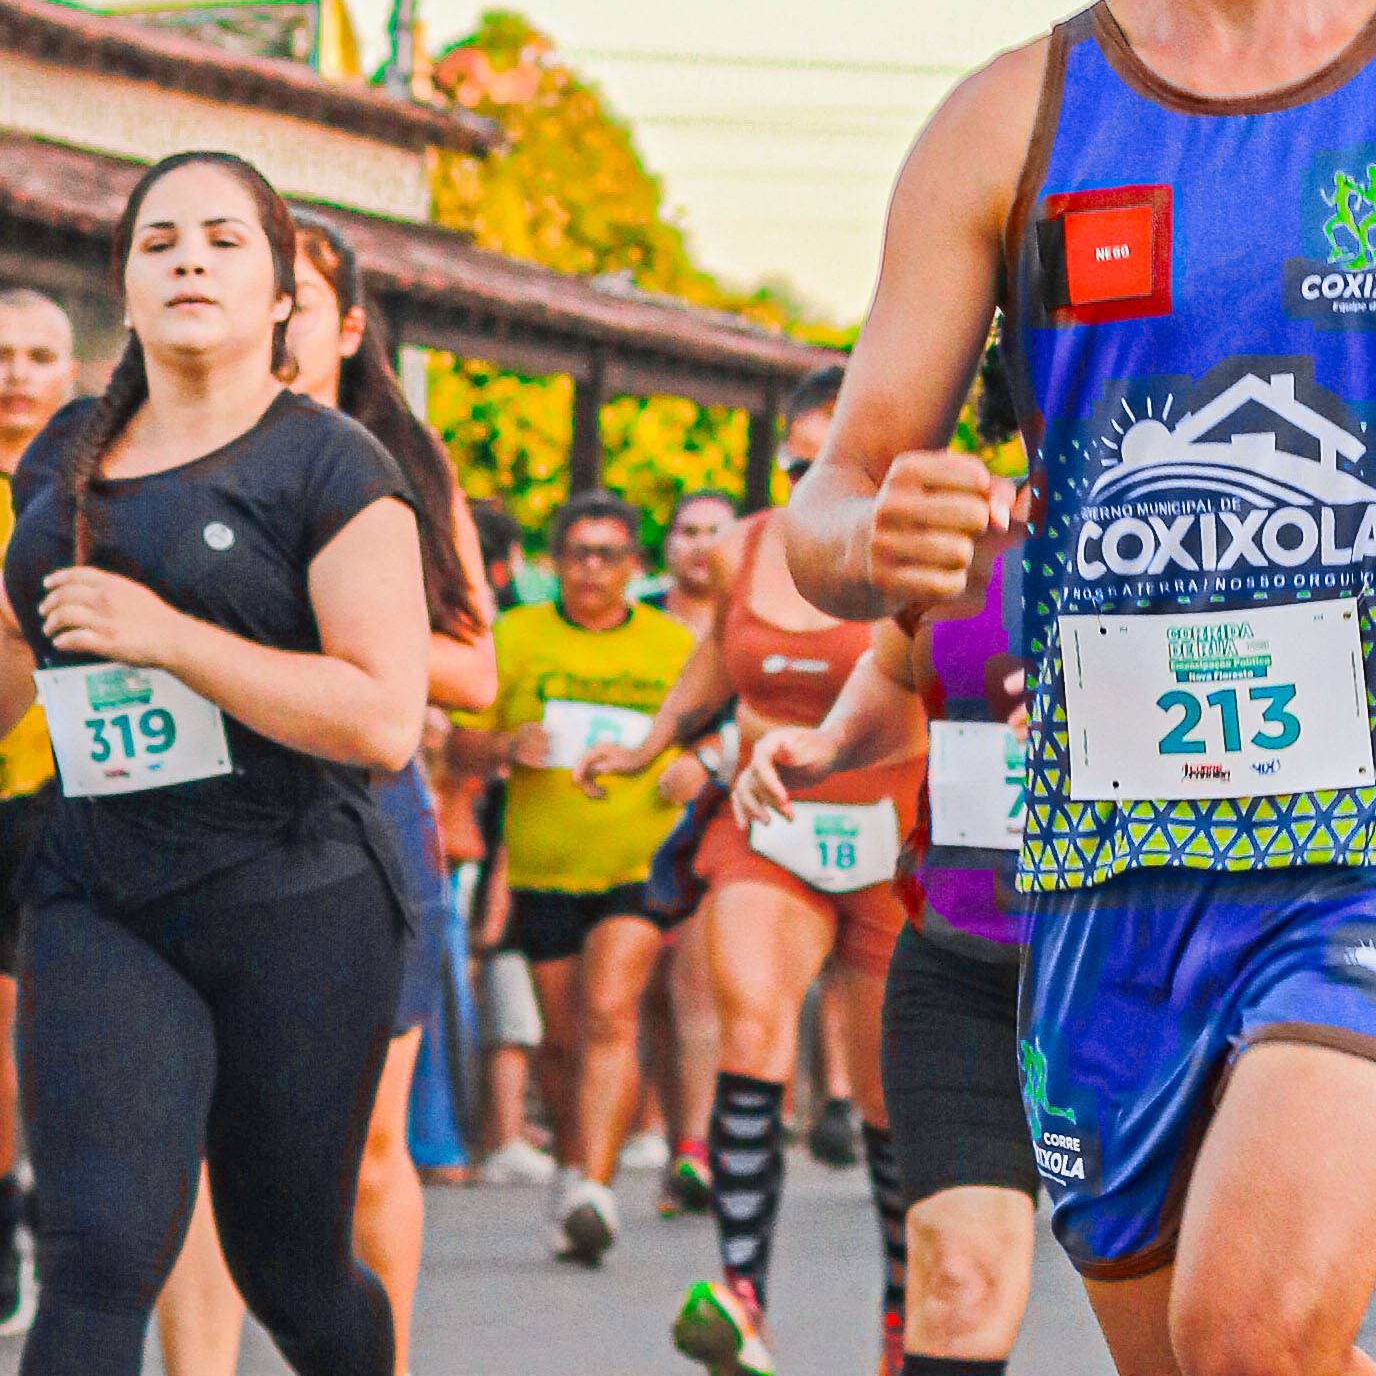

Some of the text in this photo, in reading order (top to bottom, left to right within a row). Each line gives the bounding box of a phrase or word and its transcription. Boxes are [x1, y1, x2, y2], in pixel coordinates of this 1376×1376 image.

[1137, 498, 1212, 516] MUNICIPAL
[1220, 496, 1241, 511] DE
[1156, 684, 1301, 754] 213
[85, 708, 176, 762] 319
[819, 841, 855, 868] 18
[1043, 1132, 1081, 1153] CORRE
